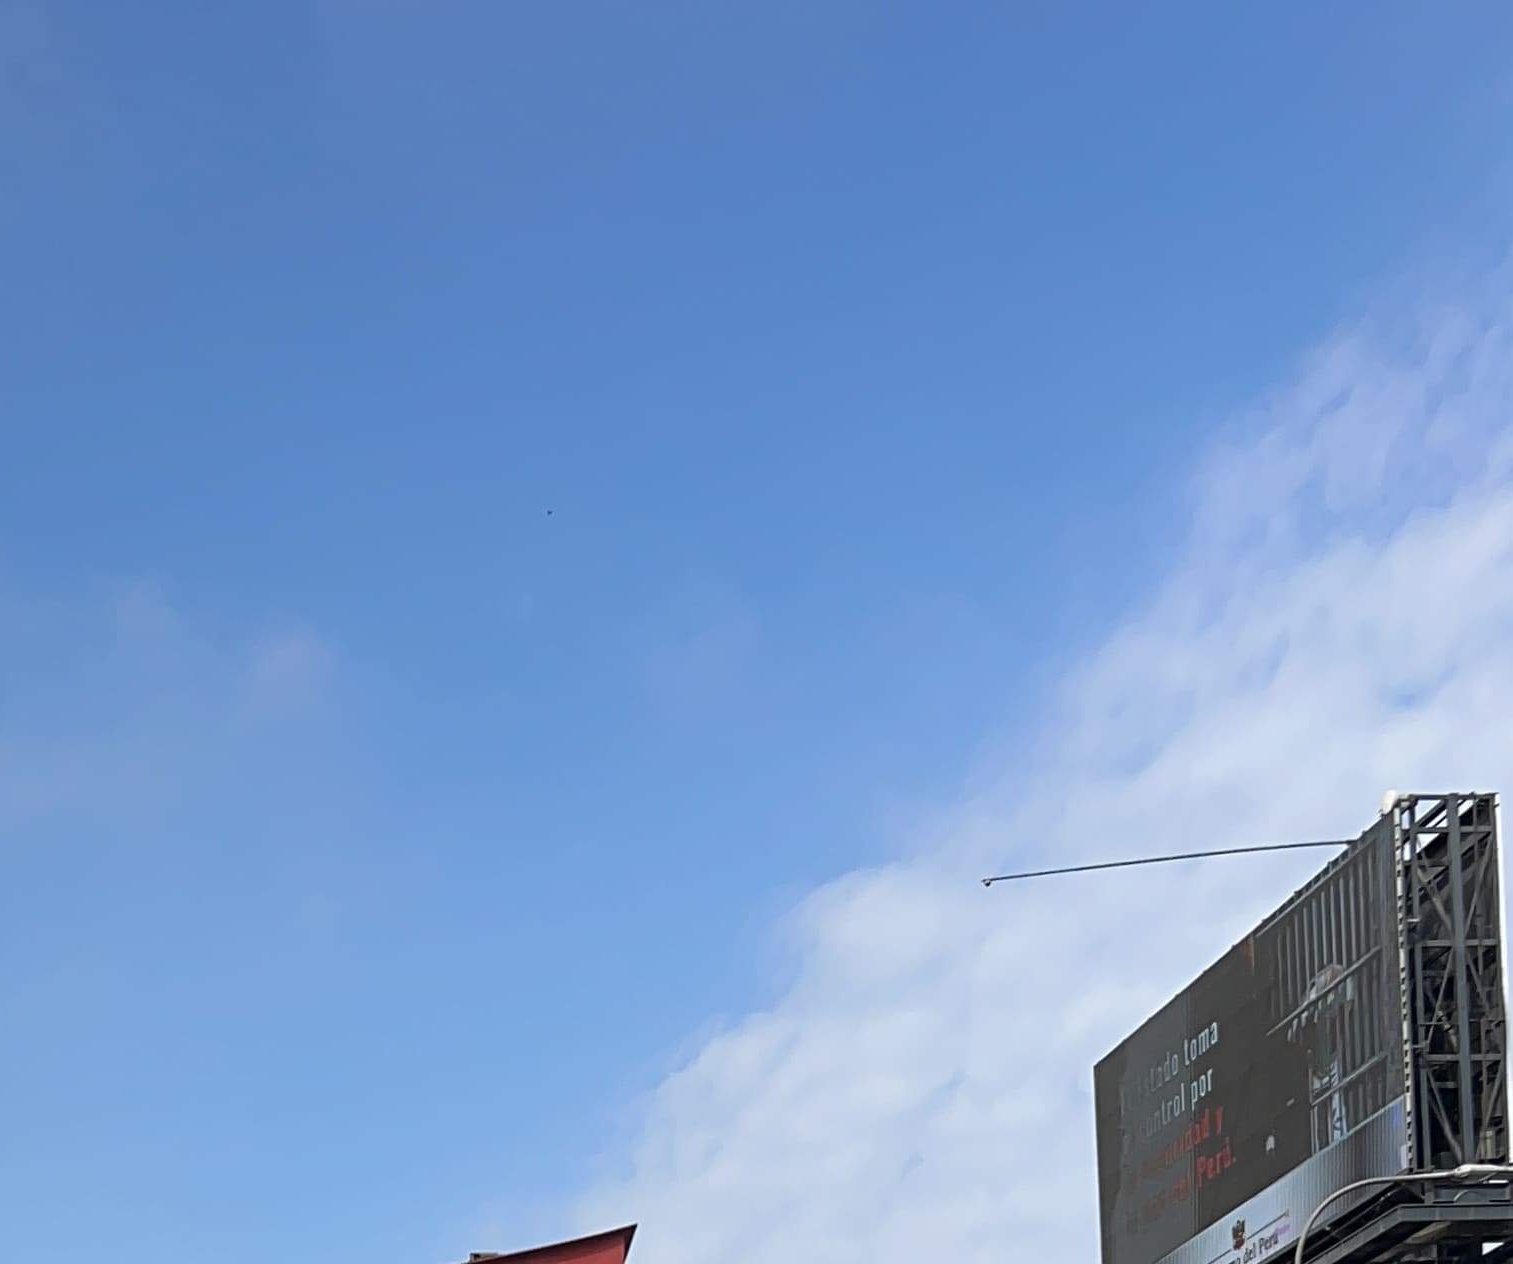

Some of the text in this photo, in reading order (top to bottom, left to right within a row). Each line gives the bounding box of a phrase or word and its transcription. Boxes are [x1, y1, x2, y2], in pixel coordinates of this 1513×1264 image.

[1183, 1021, 1219, 1067] toma
[1191, 1067, 1214, 1111] por
[1243, 1242, 1257, 1264] del
